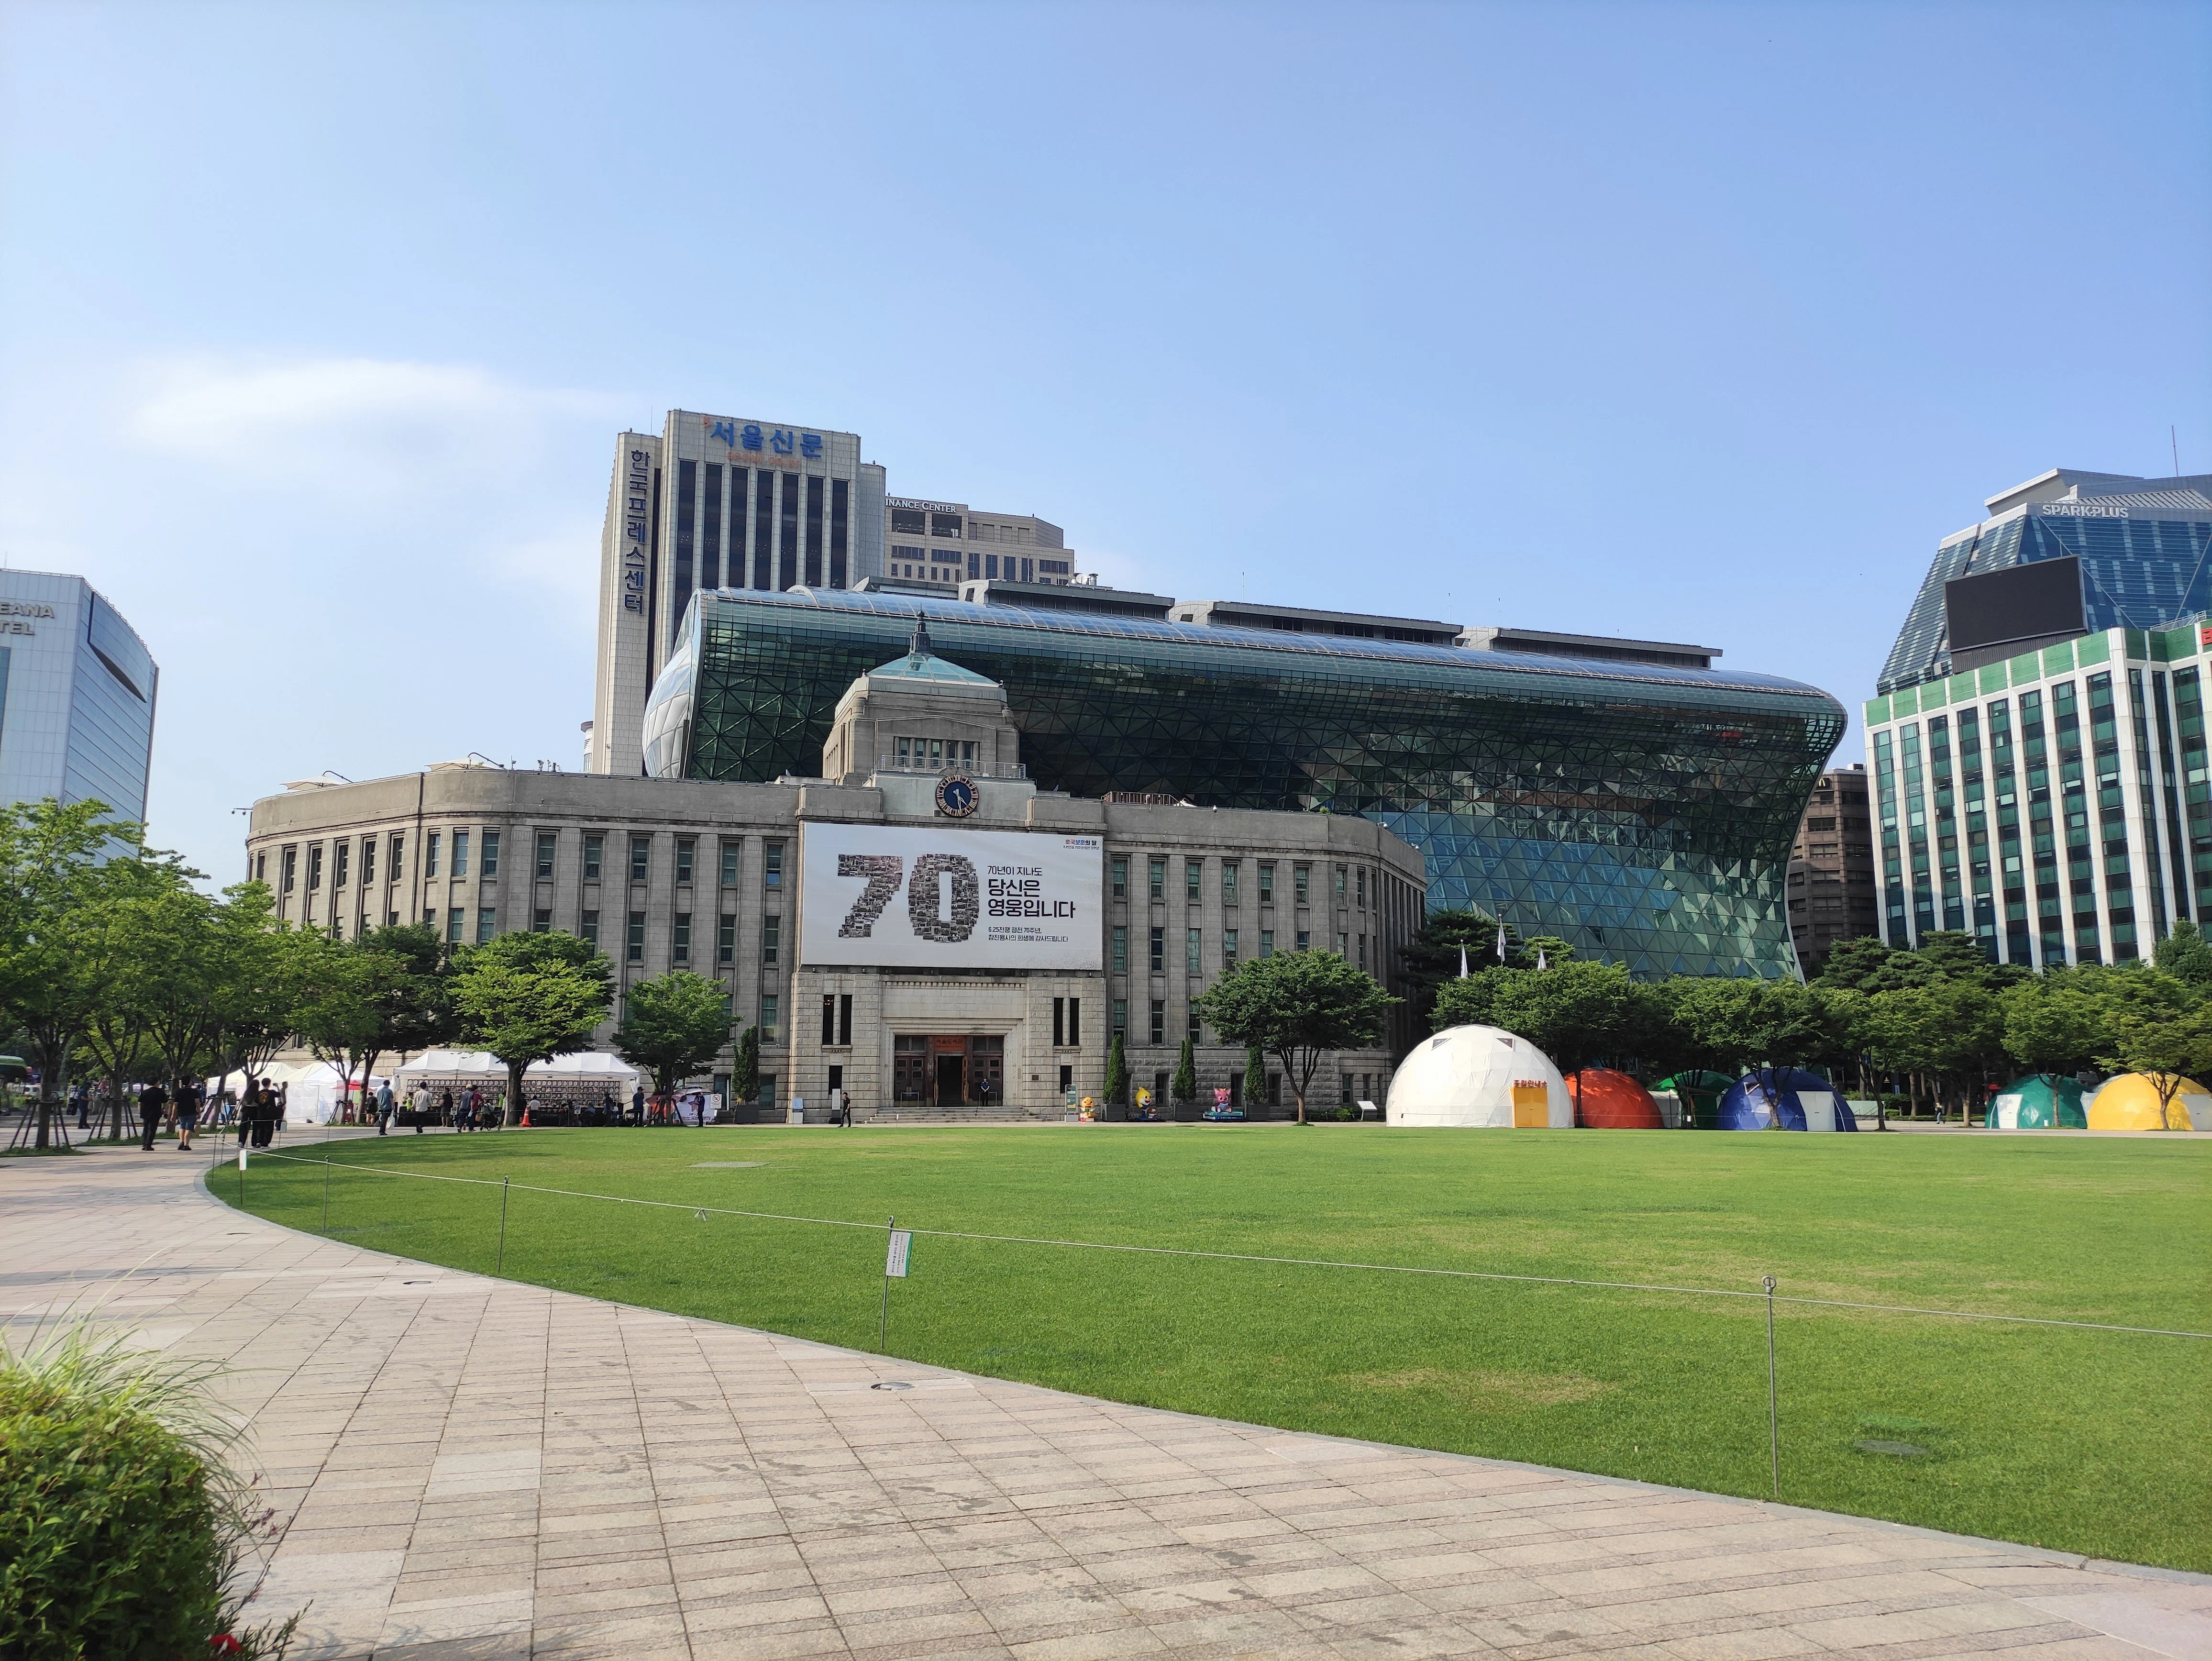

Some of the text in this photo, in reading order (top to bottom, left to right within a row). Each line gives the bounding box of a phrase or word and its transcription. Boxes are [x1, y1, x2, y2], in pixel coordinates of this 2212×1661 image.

[710, 421, 823, 458] 서울신문
[921, 501, 956, 513] CENTER
[2043, 504, 2129, 518] SPARKPLUS
[624, 450, 650, 615] 한국프레스센터
[987, 865, 1042, 876] 70년이 지나도
[988, 879, 1040, 897] 당신은
[838, 854, 979, 943] 70
[988, 898, 1076, 918] 영웅입니다
